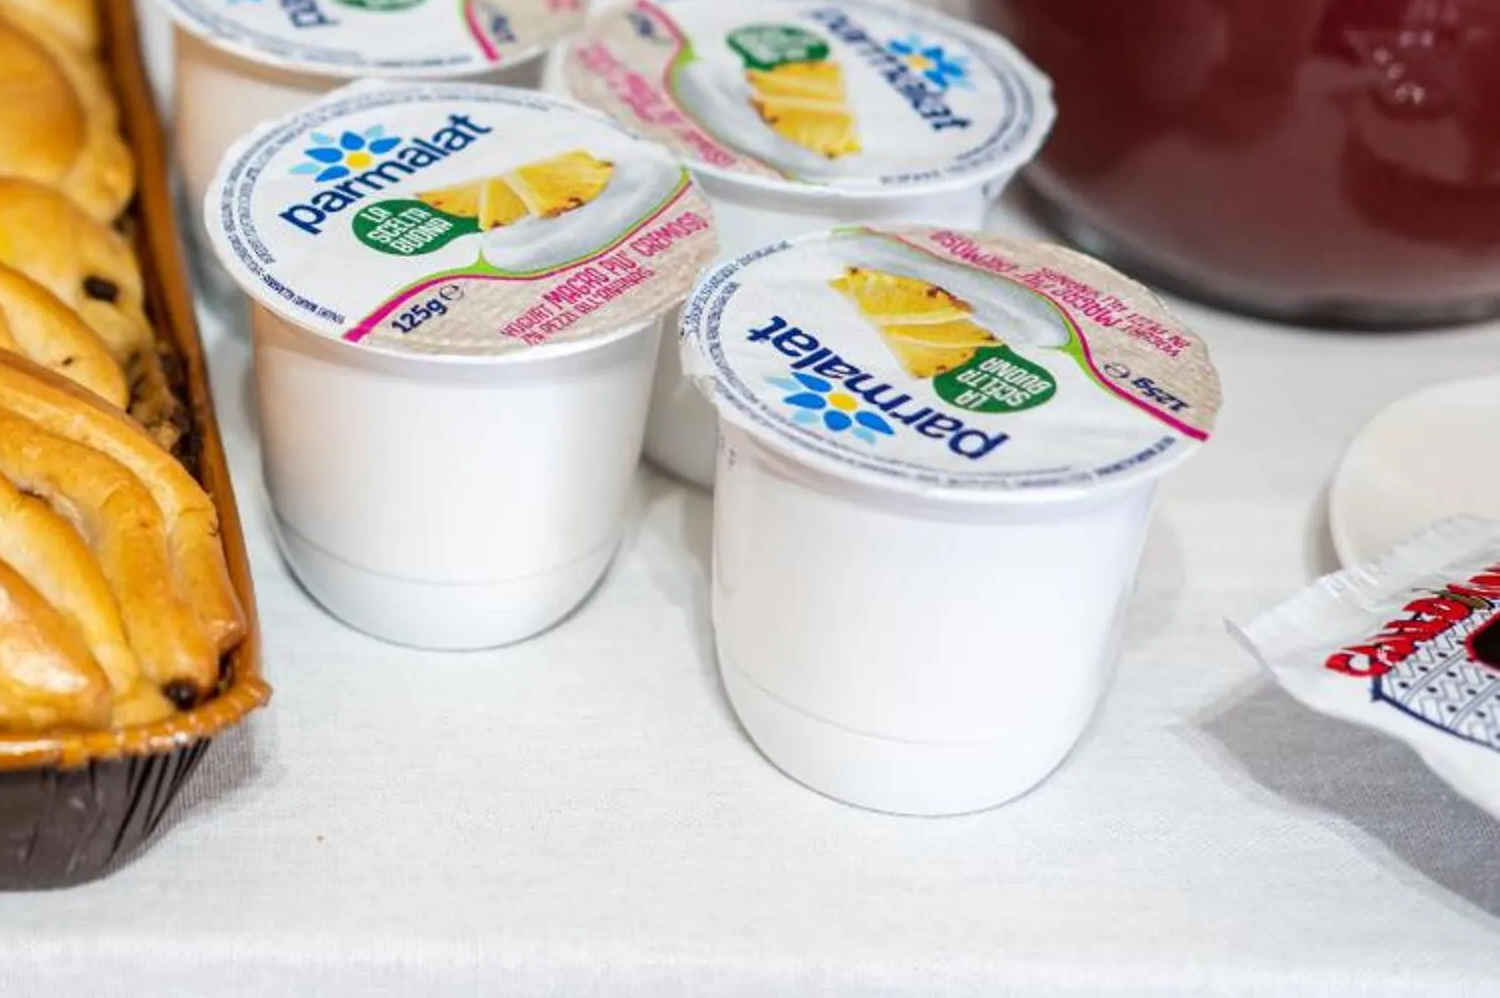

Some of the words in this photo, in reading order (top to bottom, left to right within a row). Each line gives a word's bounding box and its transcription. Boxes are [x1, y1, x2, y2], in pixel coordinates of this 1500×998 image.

[278, 113, 493, 235] parmalat
[360, 206, 392, 224] LA
[366, 207, 433, 244] SCELTA
[390, 217, 453, 254] BUONA
[542, 266, 610, 311] MAGRO
[391, 296, 448, 334] 125g
[746, 315, 1010, 460] parmalat
[1131, 377, 1189, 413] 125g
